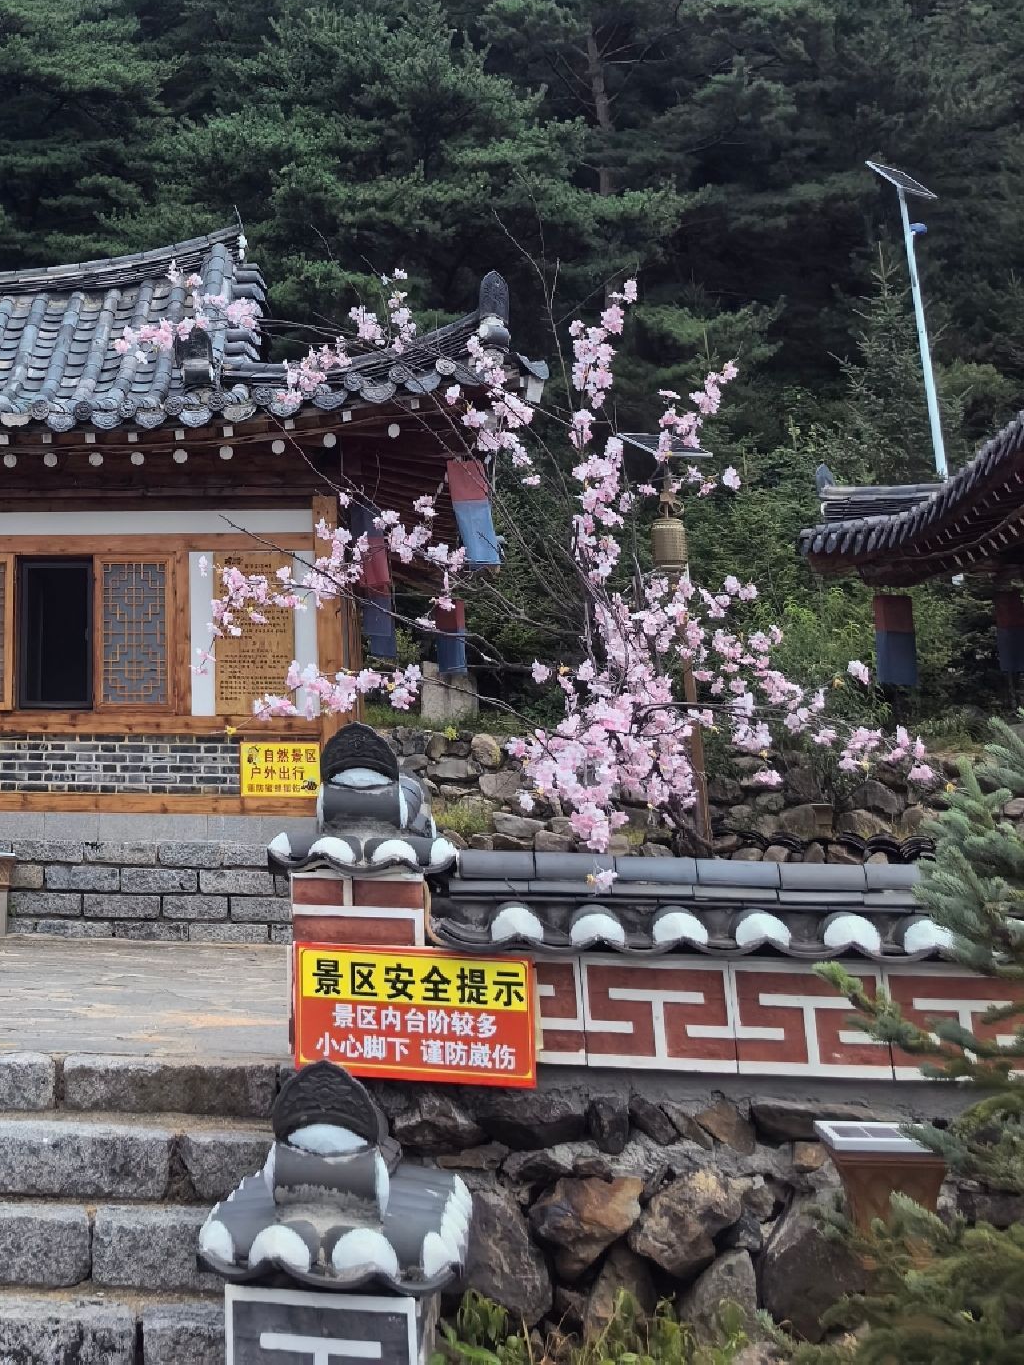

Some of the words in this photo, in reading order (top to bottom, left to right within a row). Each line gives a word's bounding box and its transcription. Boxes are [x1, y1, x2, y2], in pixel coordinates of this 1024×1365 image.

[251, 766, 305, 780] 户外出行
[265, 748, 317, 763] 自然景区
[312, 958, 525, 1007] 景区安全提示
[332, 1003, 497, 1038] 景区内台阶较多
[315, 1032, 410, 1062] 小心脚下
[420, 1039, 516, 1070] 谨防崴伤
